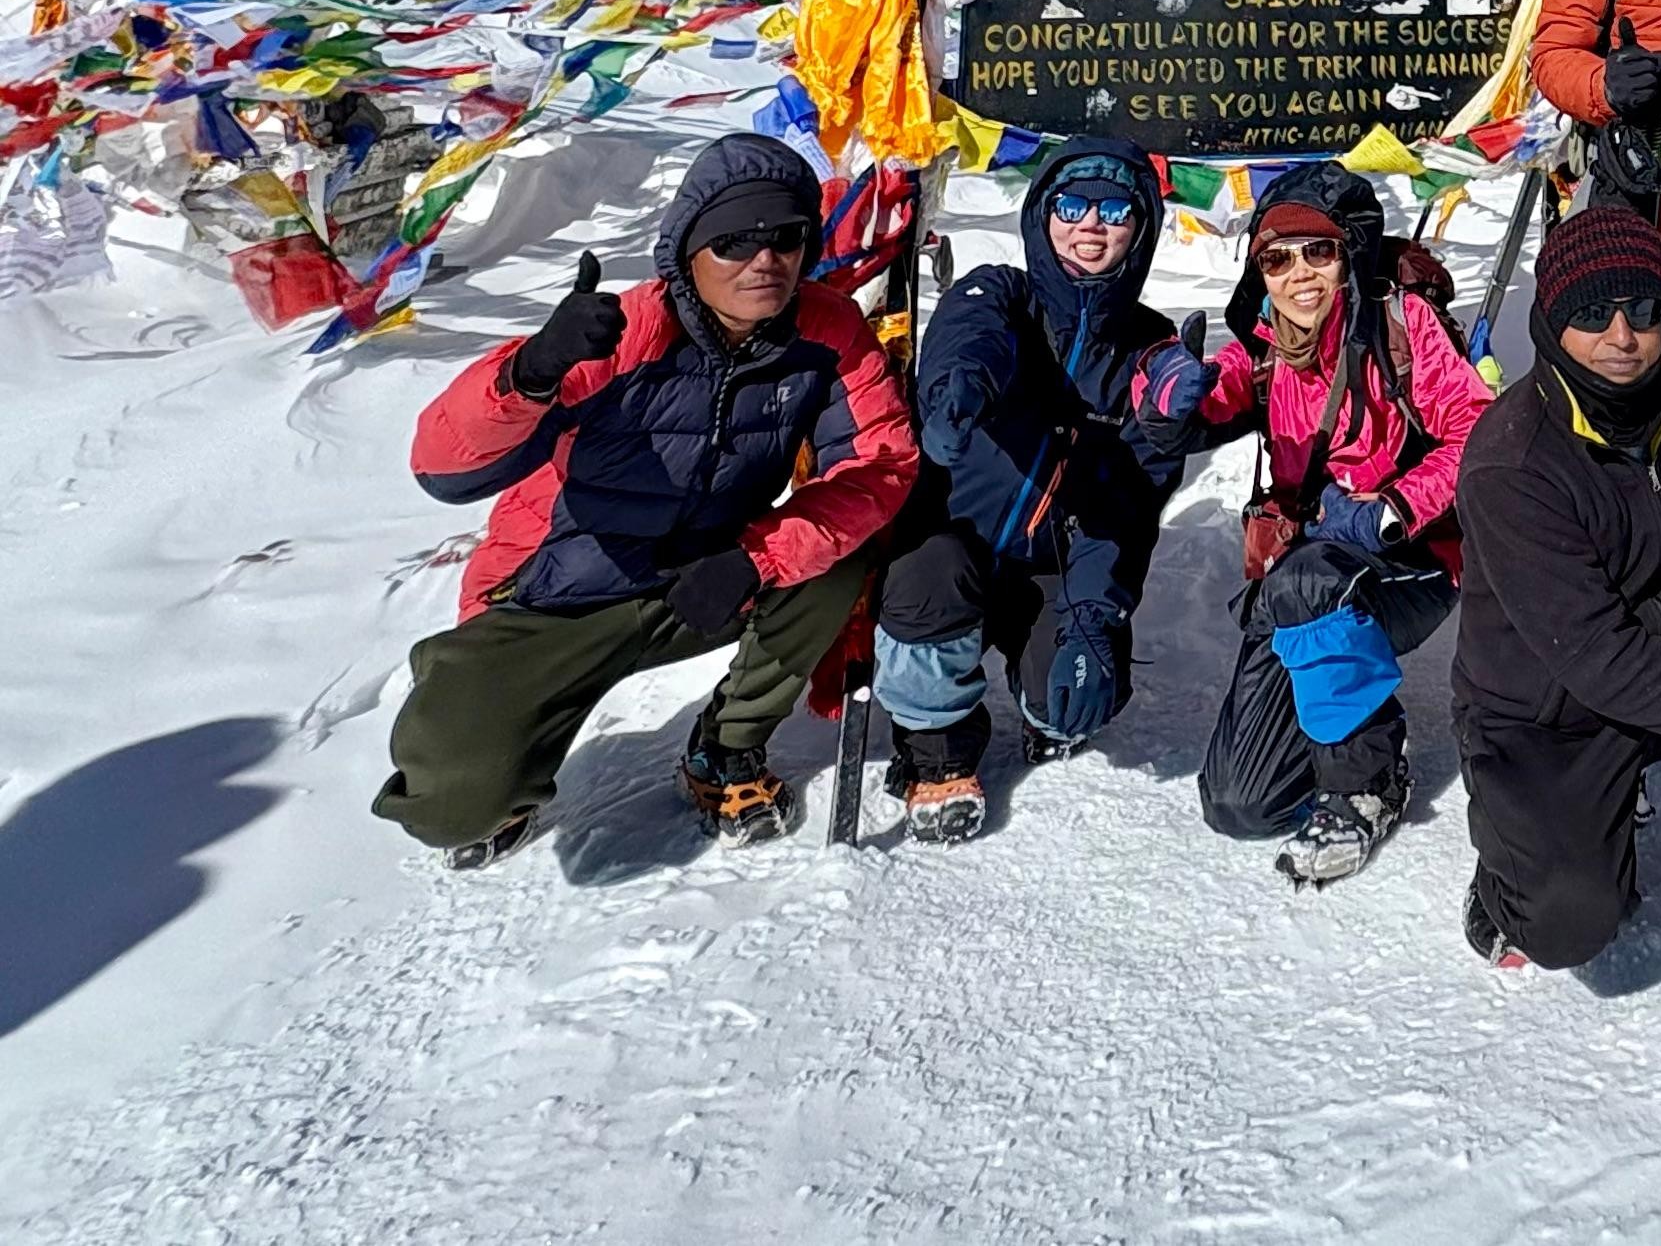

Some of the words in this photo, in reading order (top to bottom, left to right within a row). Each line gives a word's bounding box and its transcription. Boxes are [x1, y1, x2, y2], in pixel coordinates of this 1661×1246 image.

[984, 21, 1257, 53] CONGRATULATION
[1270, 21, 1327, 50] FOR
[1333, 19, 1390, 48] THE
[1397, 16, 1512, 47] SUCCESS
[971, 60, 1038, 91] HOPE
[1047, 59, 1100, 89] YOU
[1107, 57, 1226, 85] ENJOYED
[1235, 56, 1288, 83] THE
[1297, 55, 1363, 84] TREK
[1371, 54, 1397, 80] IN
[1405, 52, 1504, 80] MANANG
[1128, 94, 1199, 122] SEE
[1210, 93, 1277, 119] YOU
[1286, 88, 1381, 117] AGAIN
